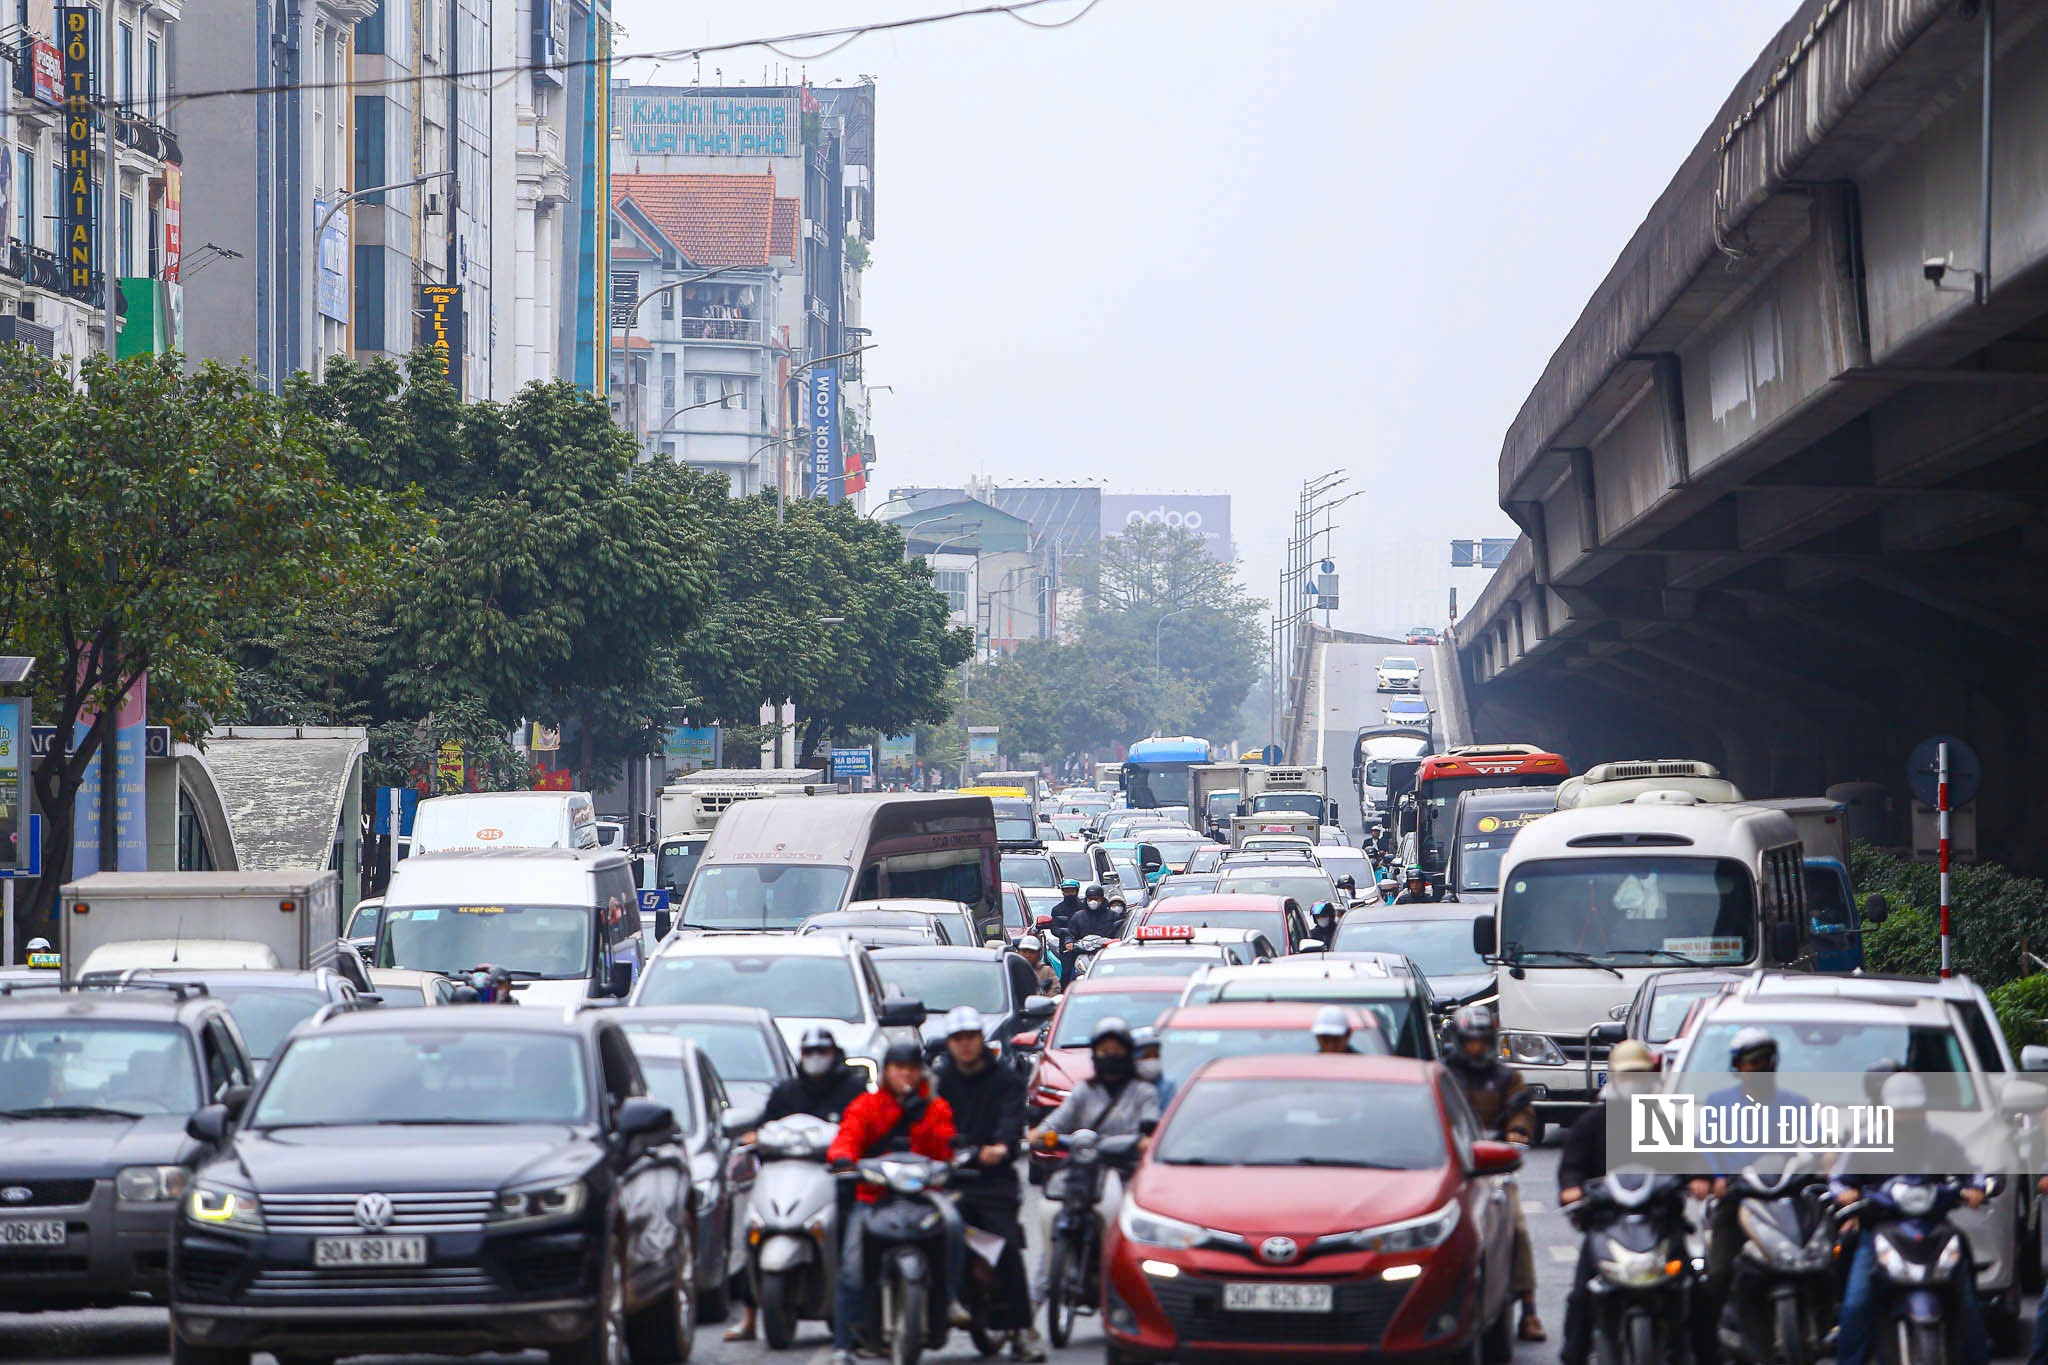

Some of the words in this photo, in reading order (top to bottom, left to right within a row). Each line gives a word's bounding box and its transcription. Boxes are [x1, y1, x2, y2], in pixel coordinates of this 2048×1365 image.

[69, 13, 86, 61] ĐỒ
[70, 73, 87, 141] THỜ
[713, 101, 785, 124] Home
[71, 149, 87, 216] HẢI
[72, 224, 88, 287] ANH
[1476, 766, 1517, 774] VIP
[480, 830, 500, 839] 215
[1140, 926, 1162, 936] Taxi
